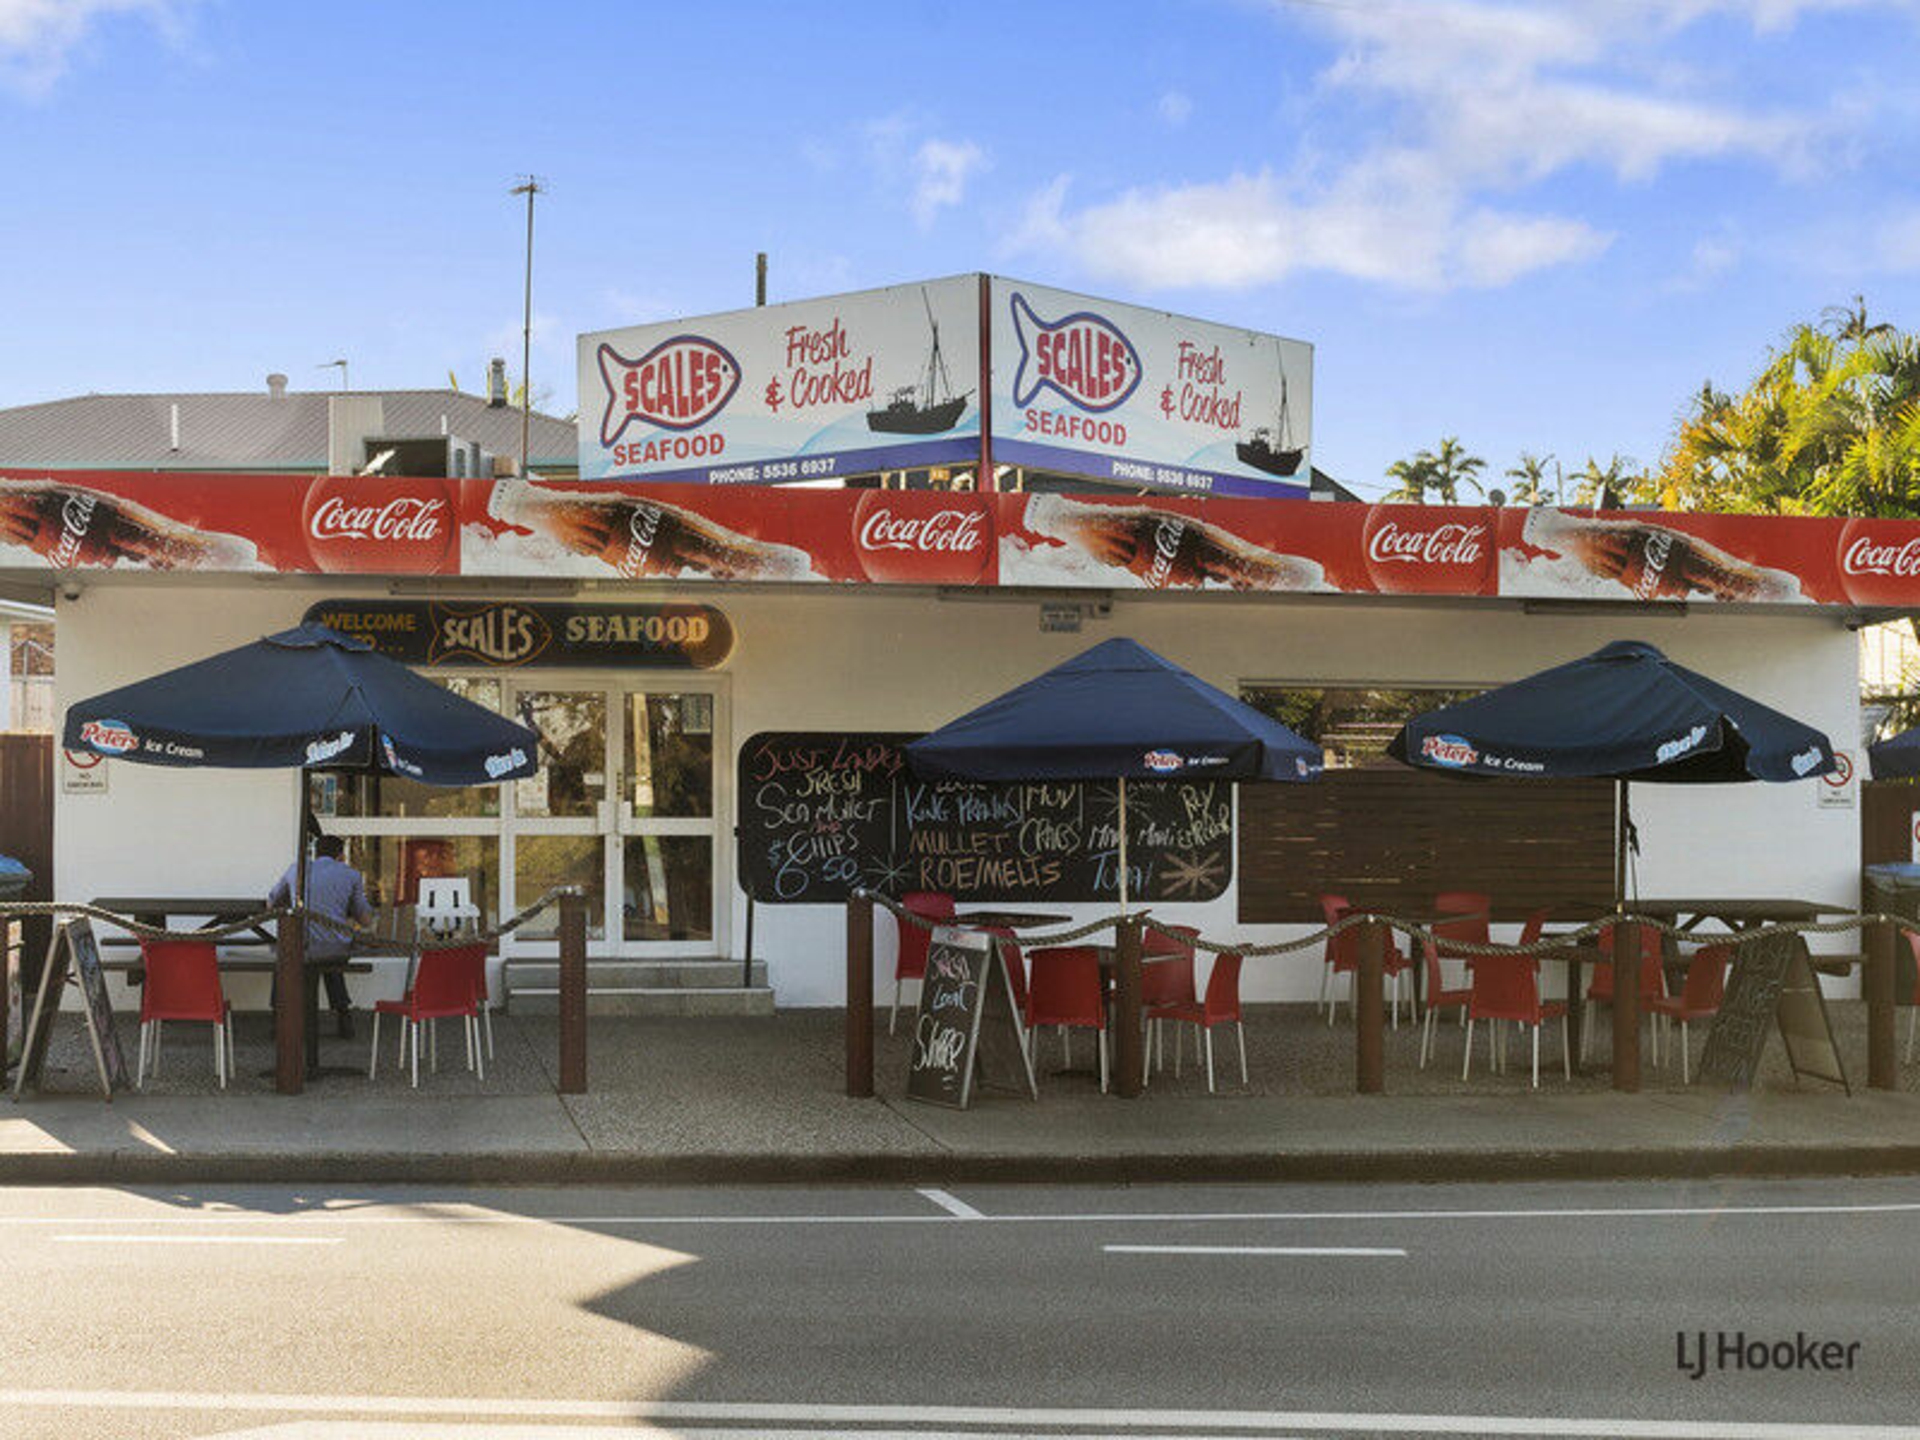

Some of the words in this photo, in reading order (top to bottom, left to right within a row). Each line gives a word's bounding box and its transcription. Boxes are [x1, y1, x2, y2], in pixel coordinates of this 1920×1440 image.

[785, 318, 851, 367] Fresh
[1037, 328, 1126, 399] SCALES
[1178, 340, 1227, 384] Fresh
[624, 350, 722, 418] SCALES
[765, 376, 784, 412] &
[791, 357, 873, 408] Cooked
[1161, 385, 1176, 420] &
[1180, 383, 1243, 429] Cooked
[1025, 409, 1127, 446] SEAFOOD
[614, 433, 724, 466] SEAFOOD
[709, 466, 759, 485] PHONE:
[311, 497, 446, 540] Coca-Cola
[860, 508, 987, 551] Coca-Cola
[1369, 522, 1486, 564] Coca-Cola
[322, 613, 416, 632] WELCOME
[443, 609, 532, 659] SCALES
[566, 615, 709, 643] SEAFOOD
[80, 723, 140, 751] Peters
[145, 741, 164, 752] Ice
[166, 743, 205, 759] Cream
[1422, 736, 1480, 766] Peters
[1483, 755, 1502, 768] Ice
[1504, 758, 1545, 773] Cream
[909, 830, 1010, 856] MULLET
